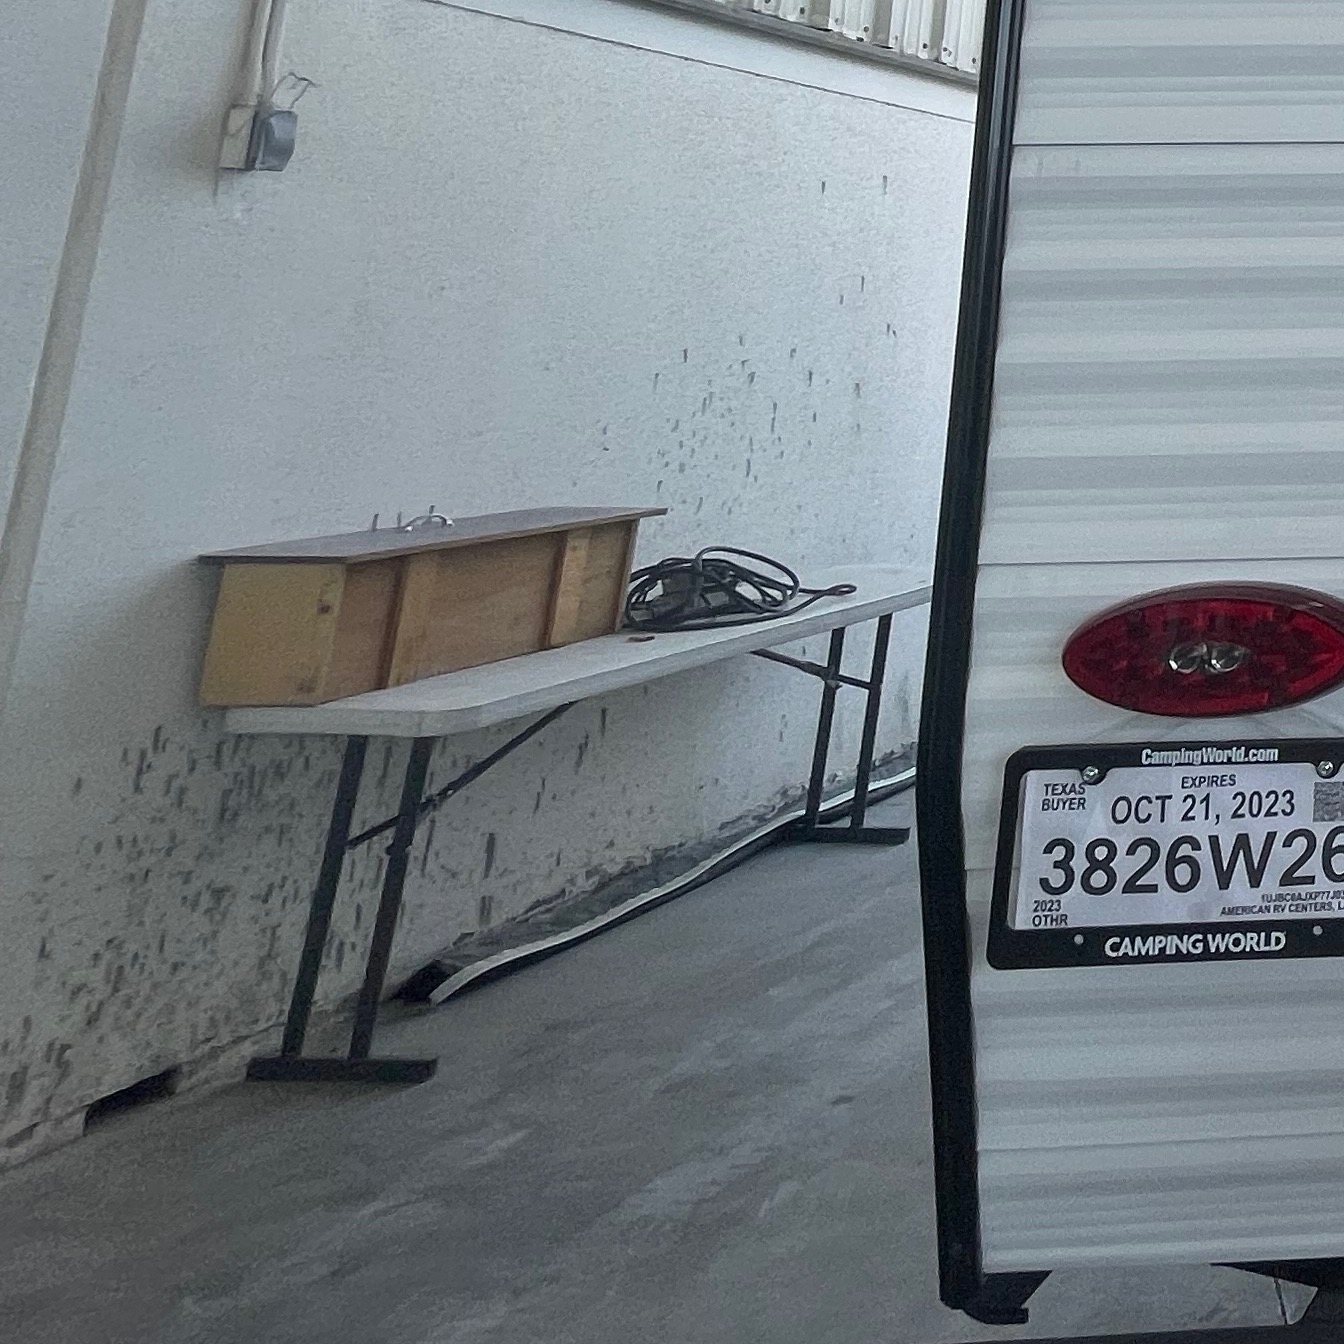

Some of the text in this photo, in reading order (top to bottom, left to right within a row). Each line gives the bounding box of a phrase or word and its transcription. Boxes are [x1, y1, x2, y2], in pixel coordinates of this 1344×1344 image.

[1141, 746, 1279, 766] CampingWorld.com
[1043, 782, 1086, 796] TEXAS
[1180, 773, 1237, 789] EXPIRES
[1041, 797, 1087, 811] BUYER
[1110, 789, 1296, 826] OCT 21, 2023
[1032, 899, 1063, 913] 2023
[1220, 904, 1271, 917] AMERICAN
[1273, 903, 1287, 914] RV
[1288, 901, 1335, 913] CENTERS,
[1031, 913, 1069, 927] OTHR
[1104, 930, 1287, 958] CAMPING WORLD
